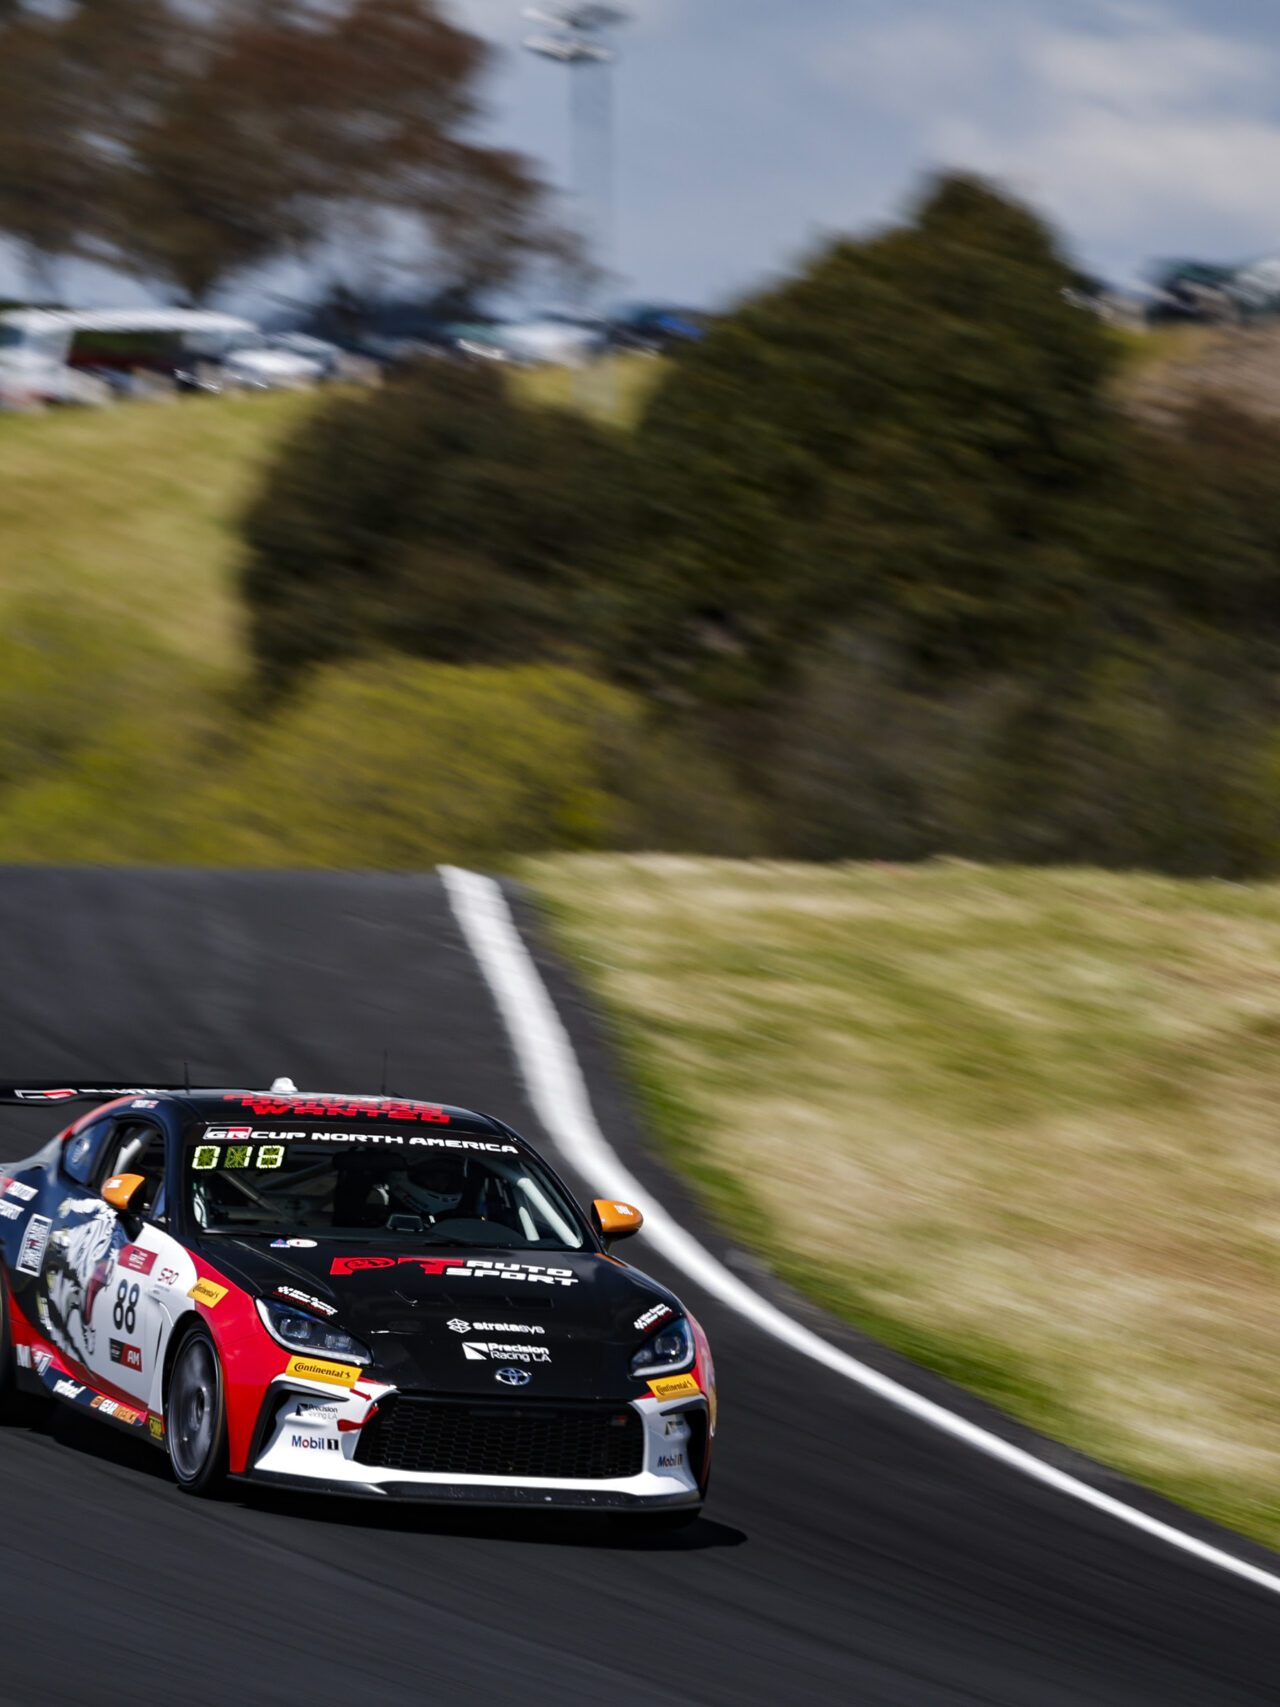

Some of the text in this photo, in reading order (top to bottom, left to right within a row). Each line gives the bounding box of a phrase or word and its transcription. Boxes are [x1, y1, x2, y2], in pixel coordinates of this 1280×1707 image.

[251, 1105, 450, 1123] WANTED
[251, 1132, 306, 1140] CUP
[311, 1132, 404, 1145] NORTH
[409, 1136, 519, 1154] AMERICA
[446, 1267, 579, 1286] SPORT
[466, 1260, 574, 1277] AUTO
[113, 1278, 140, 1335] 88
[472, 1322, 545, 1335] stratasys
[488, 1342, 550, 1355] Precision
[127, 1350, 140, 1366] AM
[490, 1351, 552, 1363] Racing LA
[293, 1362, 344, 1378] Continental
[291, 1435, 324, 1449] Mobil
